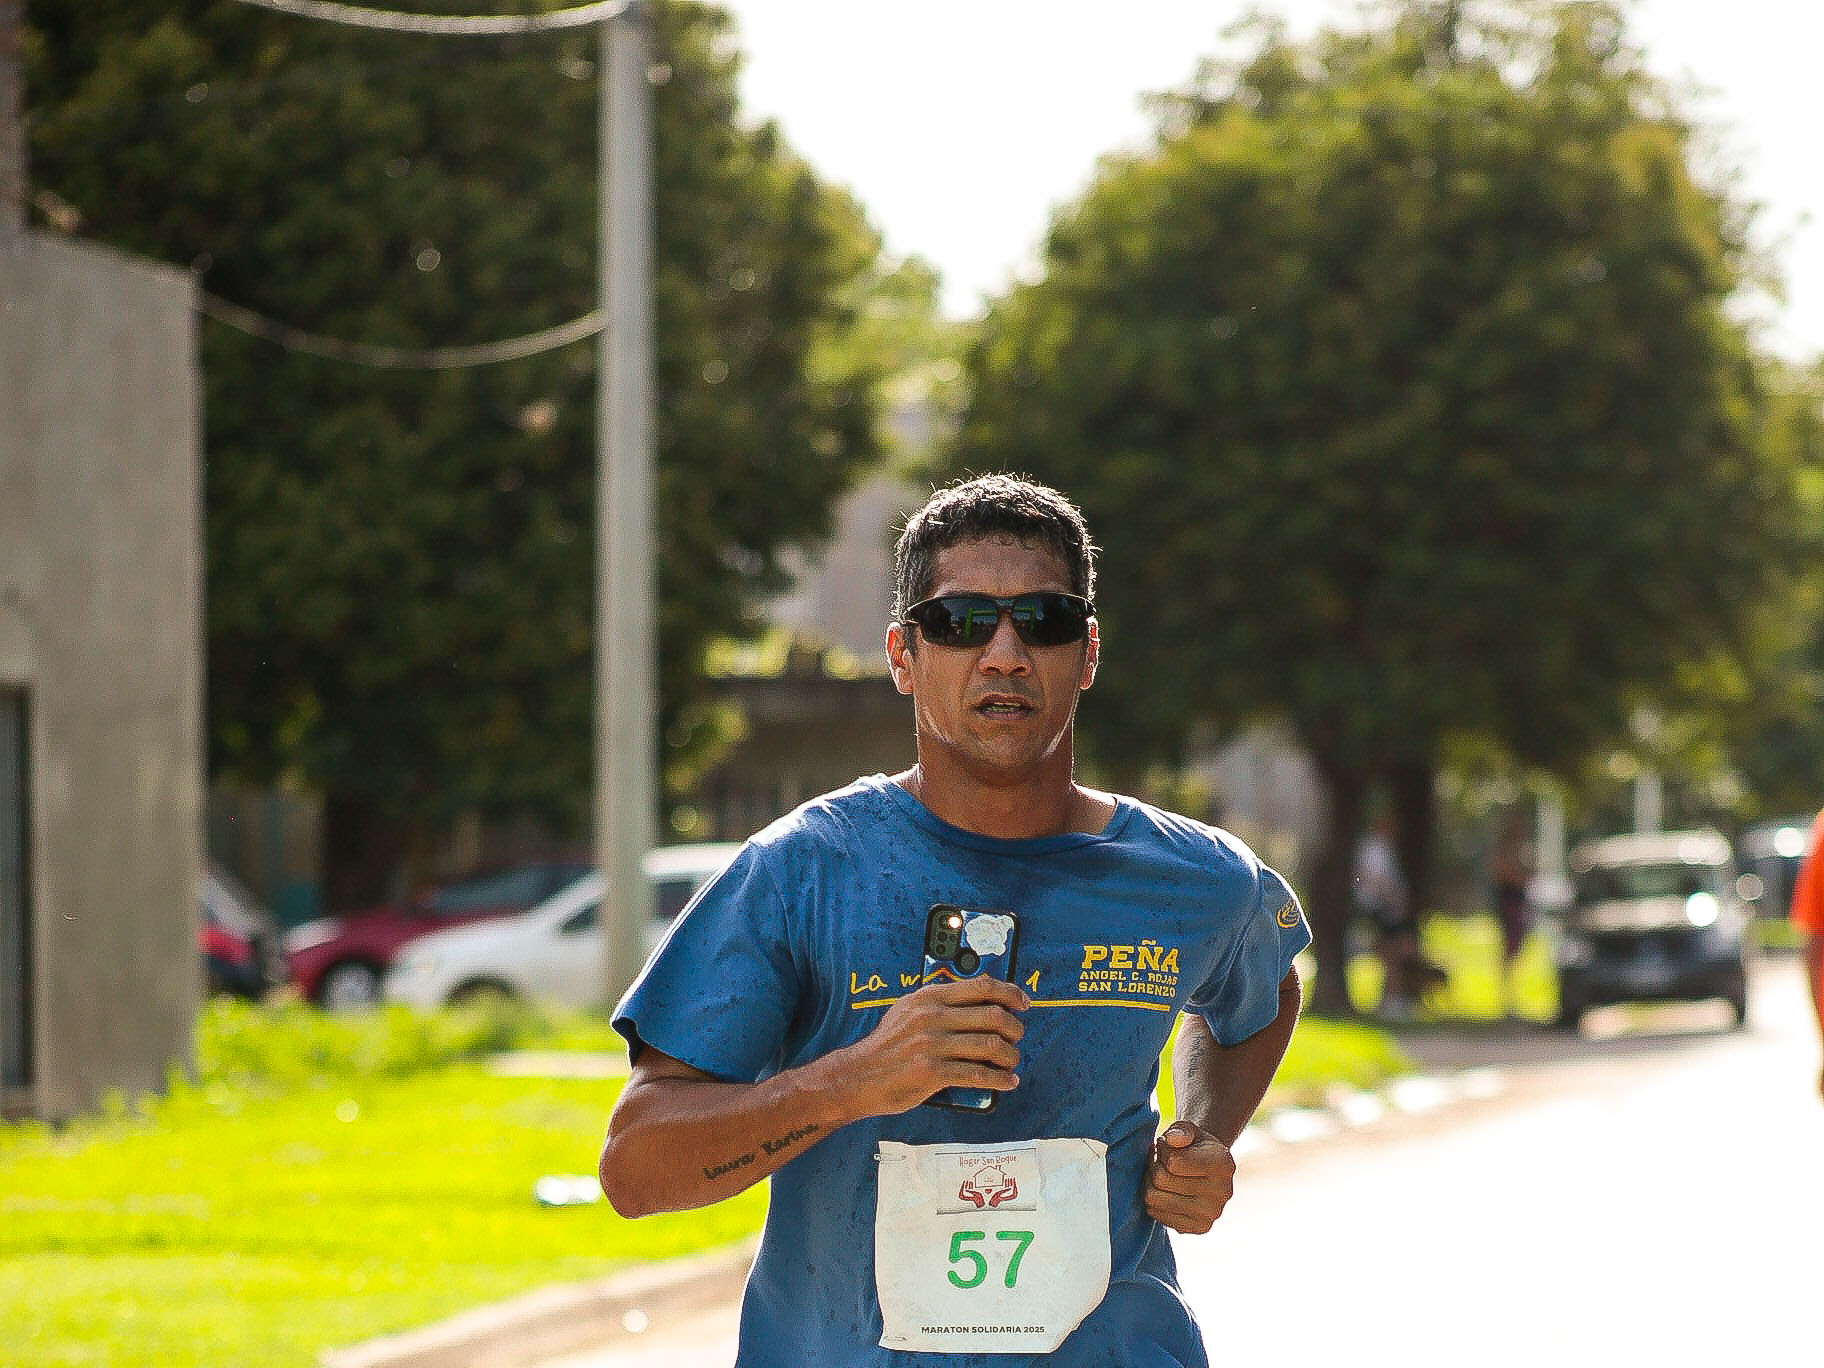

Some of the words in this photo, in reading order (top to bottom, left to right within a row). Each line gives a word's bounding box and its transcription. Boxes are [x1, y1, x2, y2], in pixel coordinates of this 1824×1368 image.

[1081, 939, 1180, 974] PEÑA
[850, 971, 889, 995] La
[1079, 970, 1127, 981] ANGEL
[1131, 971, 1143, 981] C.
[1147, 972, 1178, 986] ROJAS
[1078, 981, 1112, 992] SAN
[1117, 981, 1176, 999] LORENZO
[947, 1230, 1035, 1289] 57
[921, 1325, 970, 1334] MARATON
[971, 1325, 1022, 1334] SOLIDARIA
[1023, 1325, 1045, 1334] 2025
